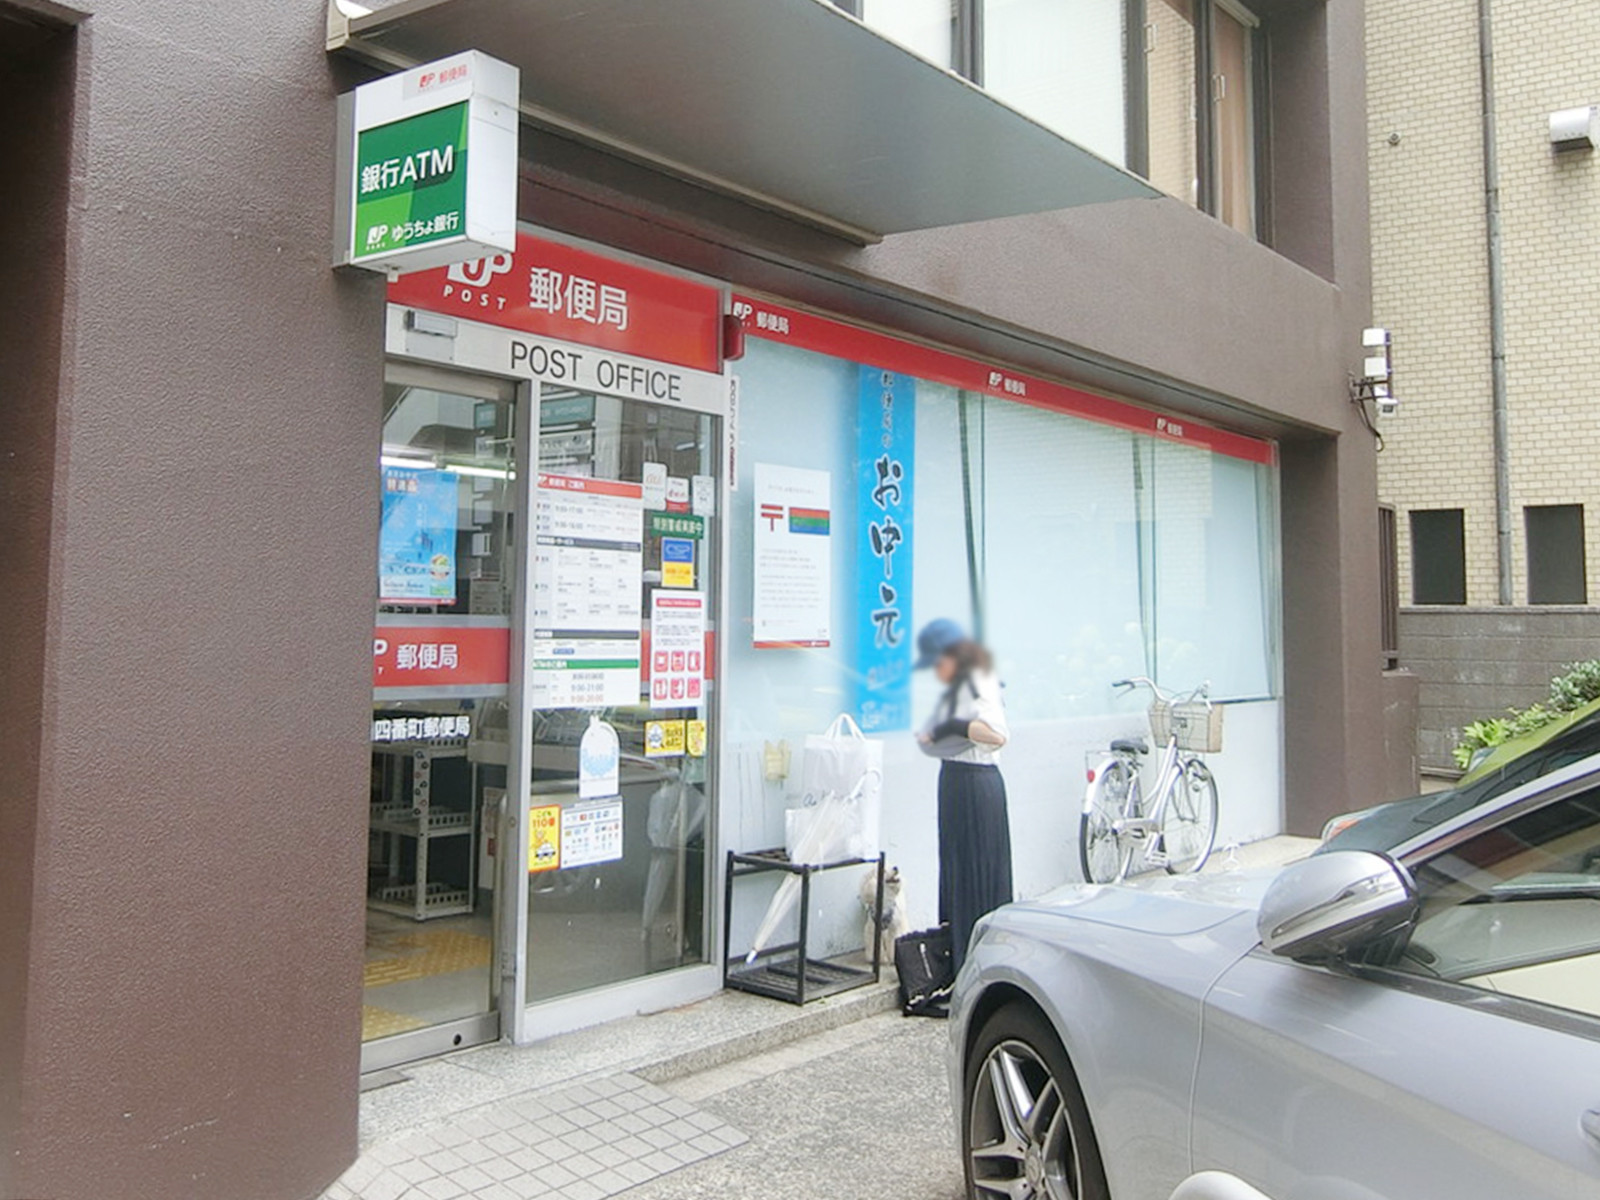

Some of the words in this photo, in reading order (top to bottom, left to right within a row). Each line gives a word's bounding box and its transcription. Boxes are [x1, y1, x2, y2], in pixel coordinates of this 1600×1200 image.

[361, 145, 454, 193] 銀行ATM
[391, 211, 459, 241] ゆうちょ銀行
[443, 284, 507, 311] POST
[529, 266, 628, 331] 郵便局
[756, 311, 790, 334] 郵便局
[511, 340, 583, 381] POST
[597, 359, 682, 401] OFFICE
[870, 453, 904, 646] お中元
[396, 643, 459, 670] 郵便局
[374, 716, 470, 740] 四番町郵便局
